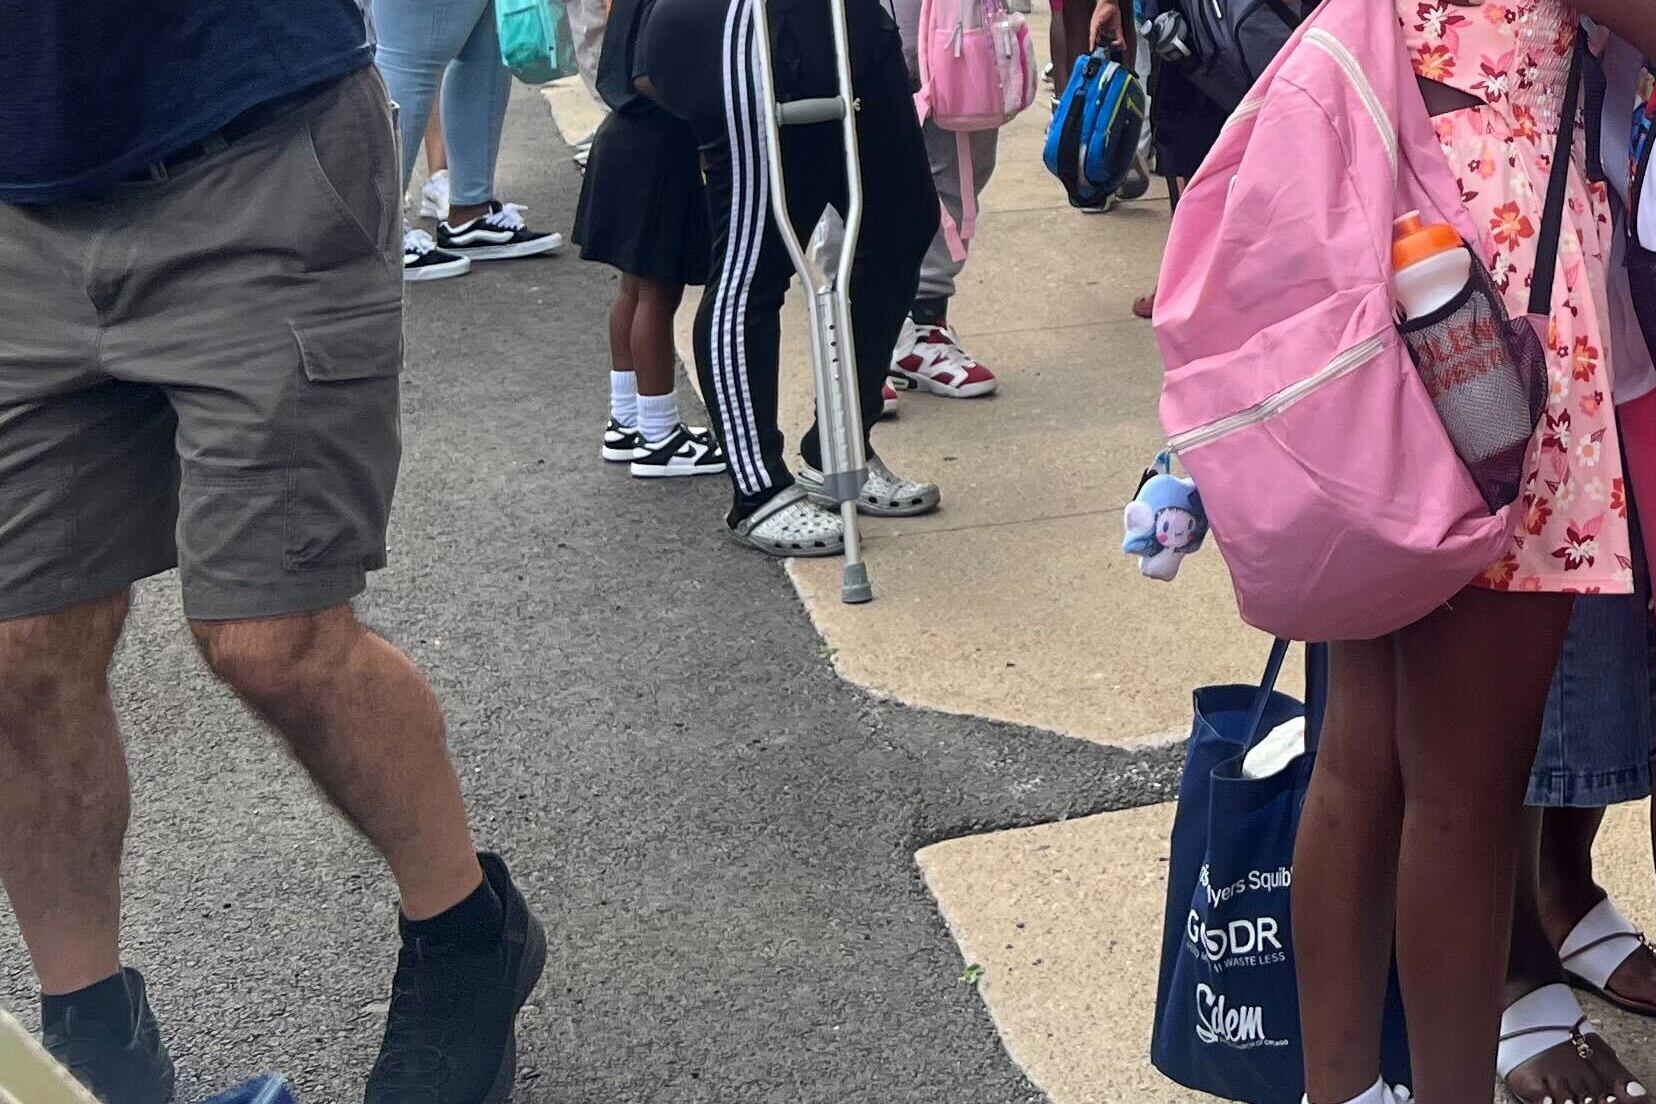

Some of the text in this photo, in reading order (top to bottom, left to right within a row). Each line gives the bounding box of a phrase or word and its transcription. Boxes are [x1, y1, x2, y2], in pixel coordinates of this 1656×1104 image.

[1248, 866, 1294, 893] Squib
[1224, 955, 1257, 969] WASTE
[1258, 951, 1286, 965] LESS
